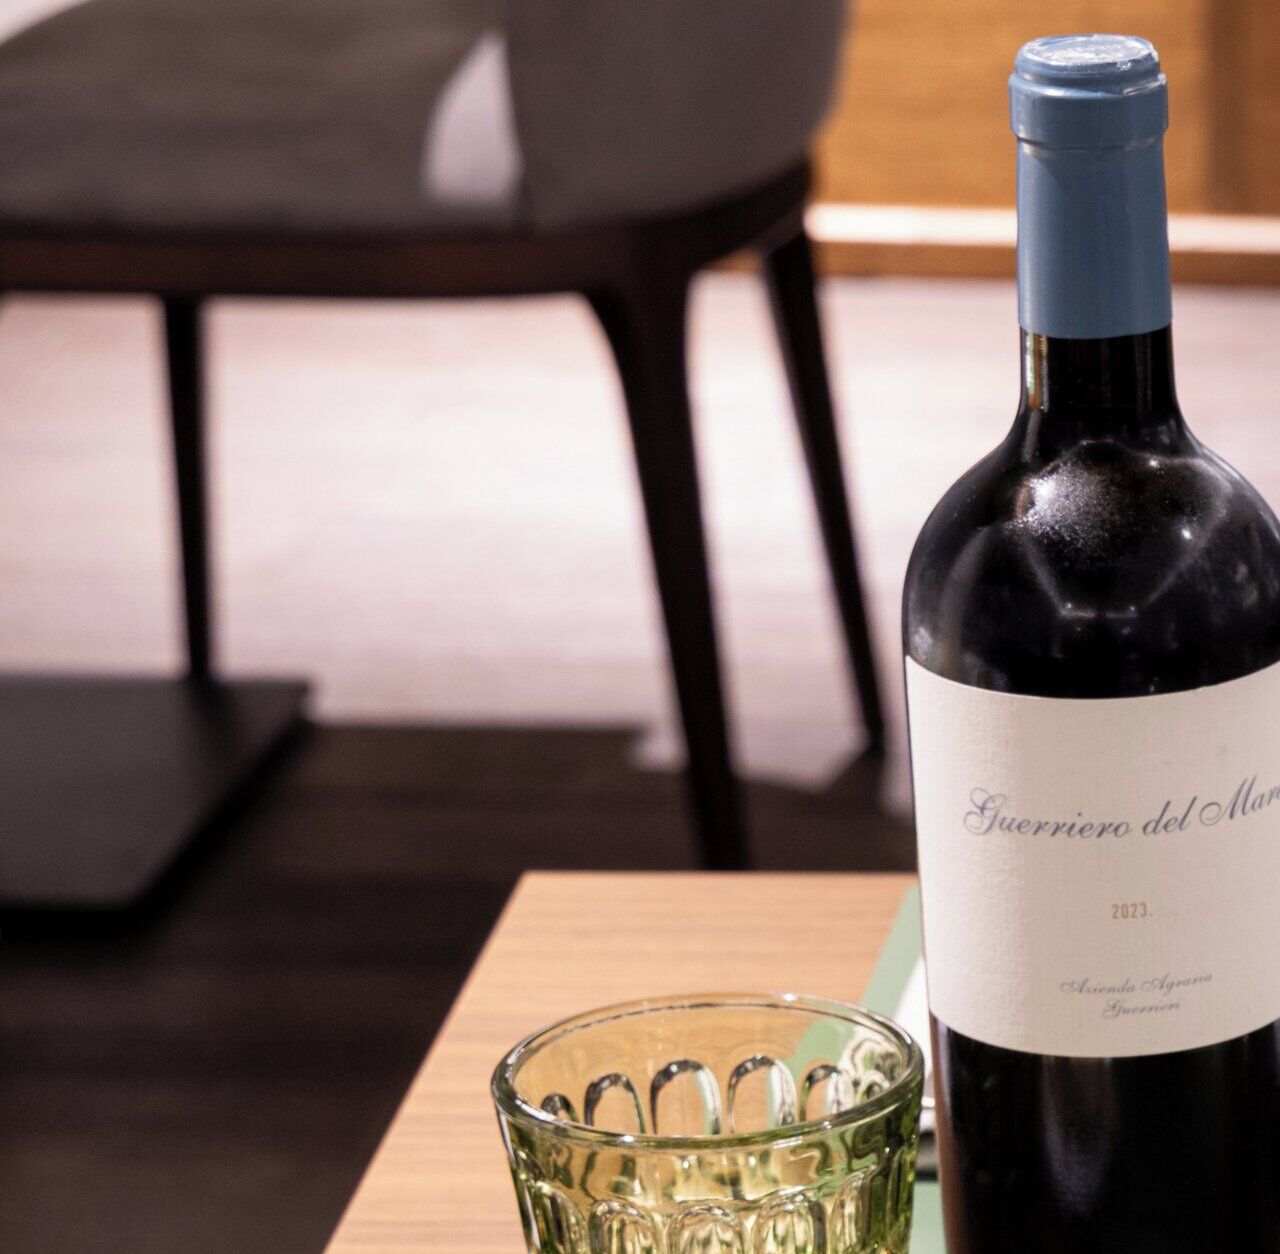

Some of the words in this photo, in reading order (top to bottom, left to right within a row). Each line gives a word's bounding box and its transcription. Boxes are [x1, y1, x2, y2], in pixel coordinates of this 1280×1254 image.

[963, 787, 1132, 838] Guerriero
[1142, 796, 1198, 837] del
[1059, 977, 1136, 995] Azienda
[1140, 972, 1213, 997] Agraria
